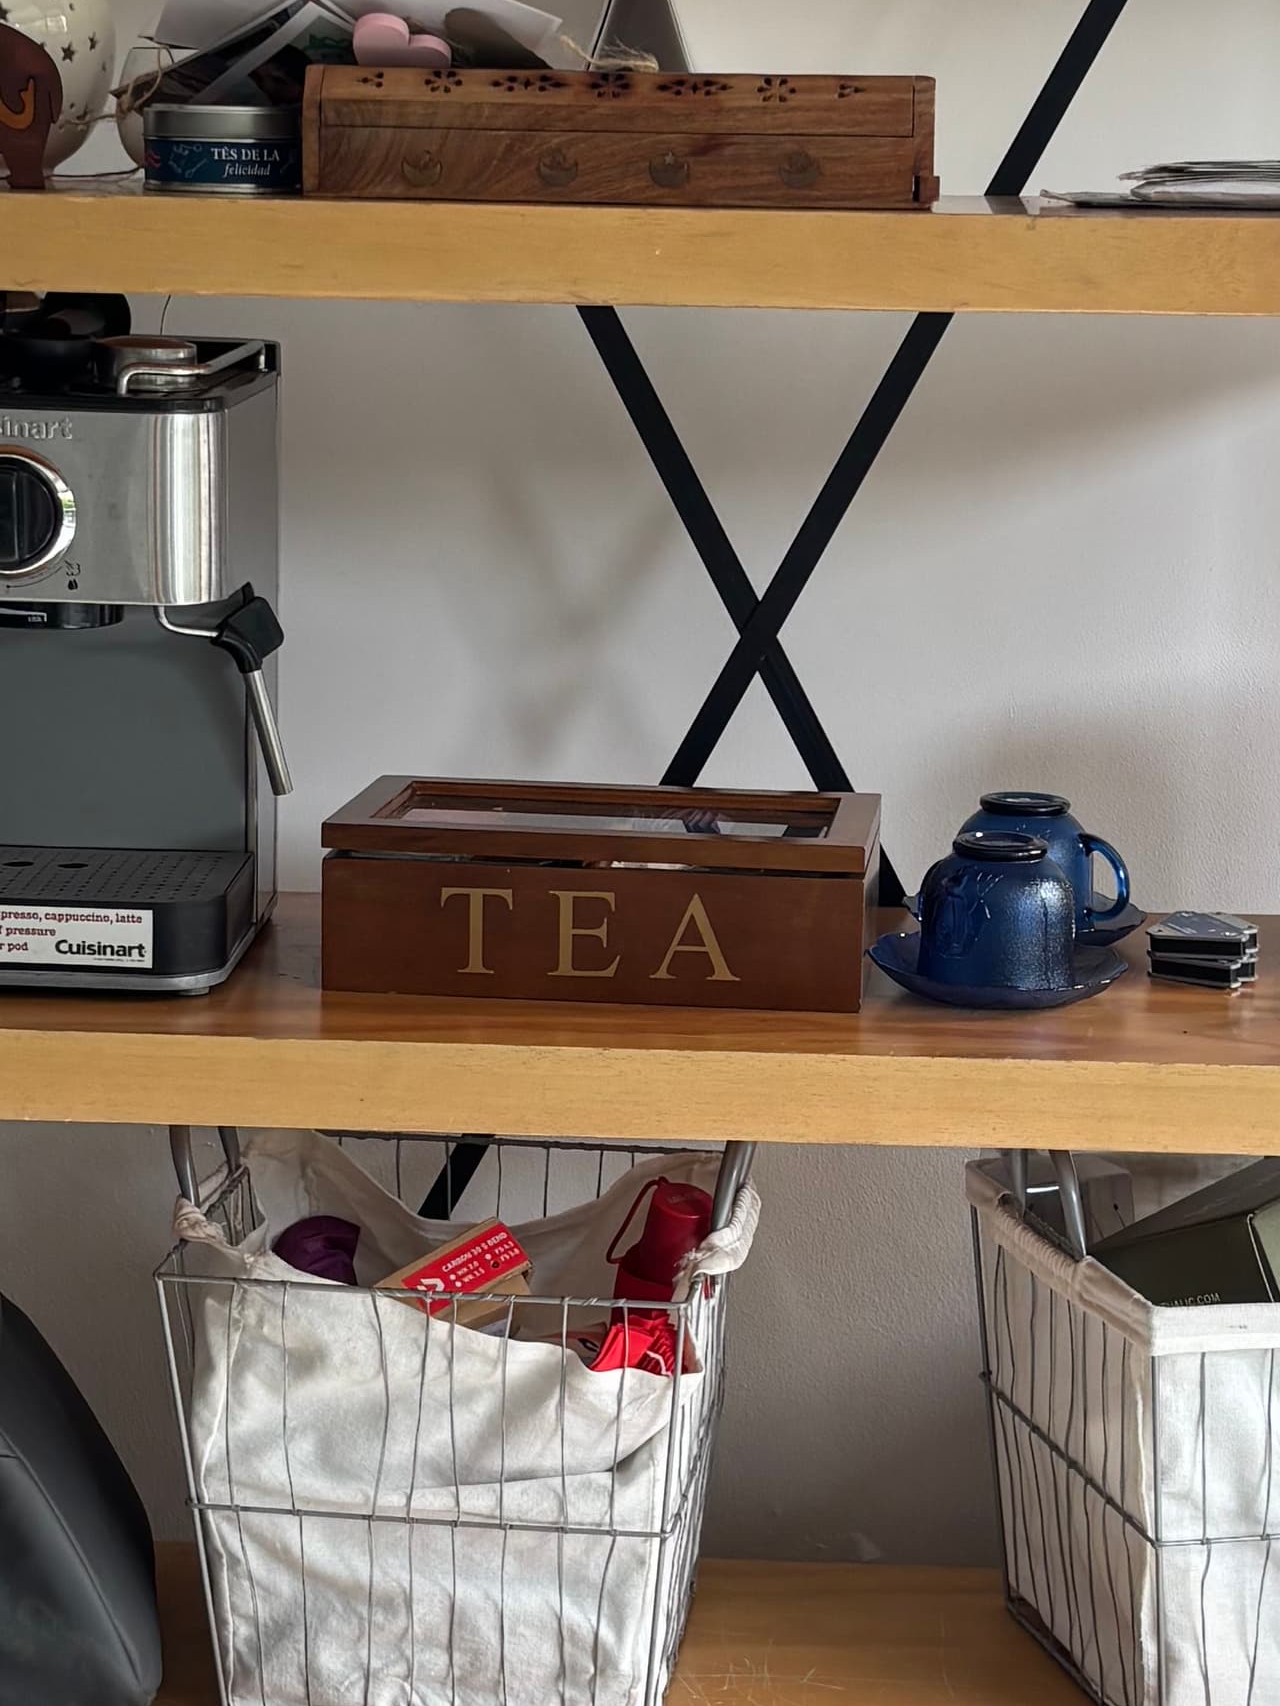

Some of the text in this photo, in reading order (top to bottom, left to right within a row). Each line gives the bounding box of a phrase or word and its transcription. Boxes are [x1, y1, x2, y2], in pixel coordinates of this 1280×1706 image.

[241, 149, 261, 161] DE
[263, 149, 280, 162] LA
[222, 163, 271, 178] felicidad
[115, 913, 143, 924] latte
[5, 927, 57, 938] pressure
[440, 886, 741, 982] TEA
[7, 941, 29, 953] pod
[55, 939, 146, 958] Cuisinart
